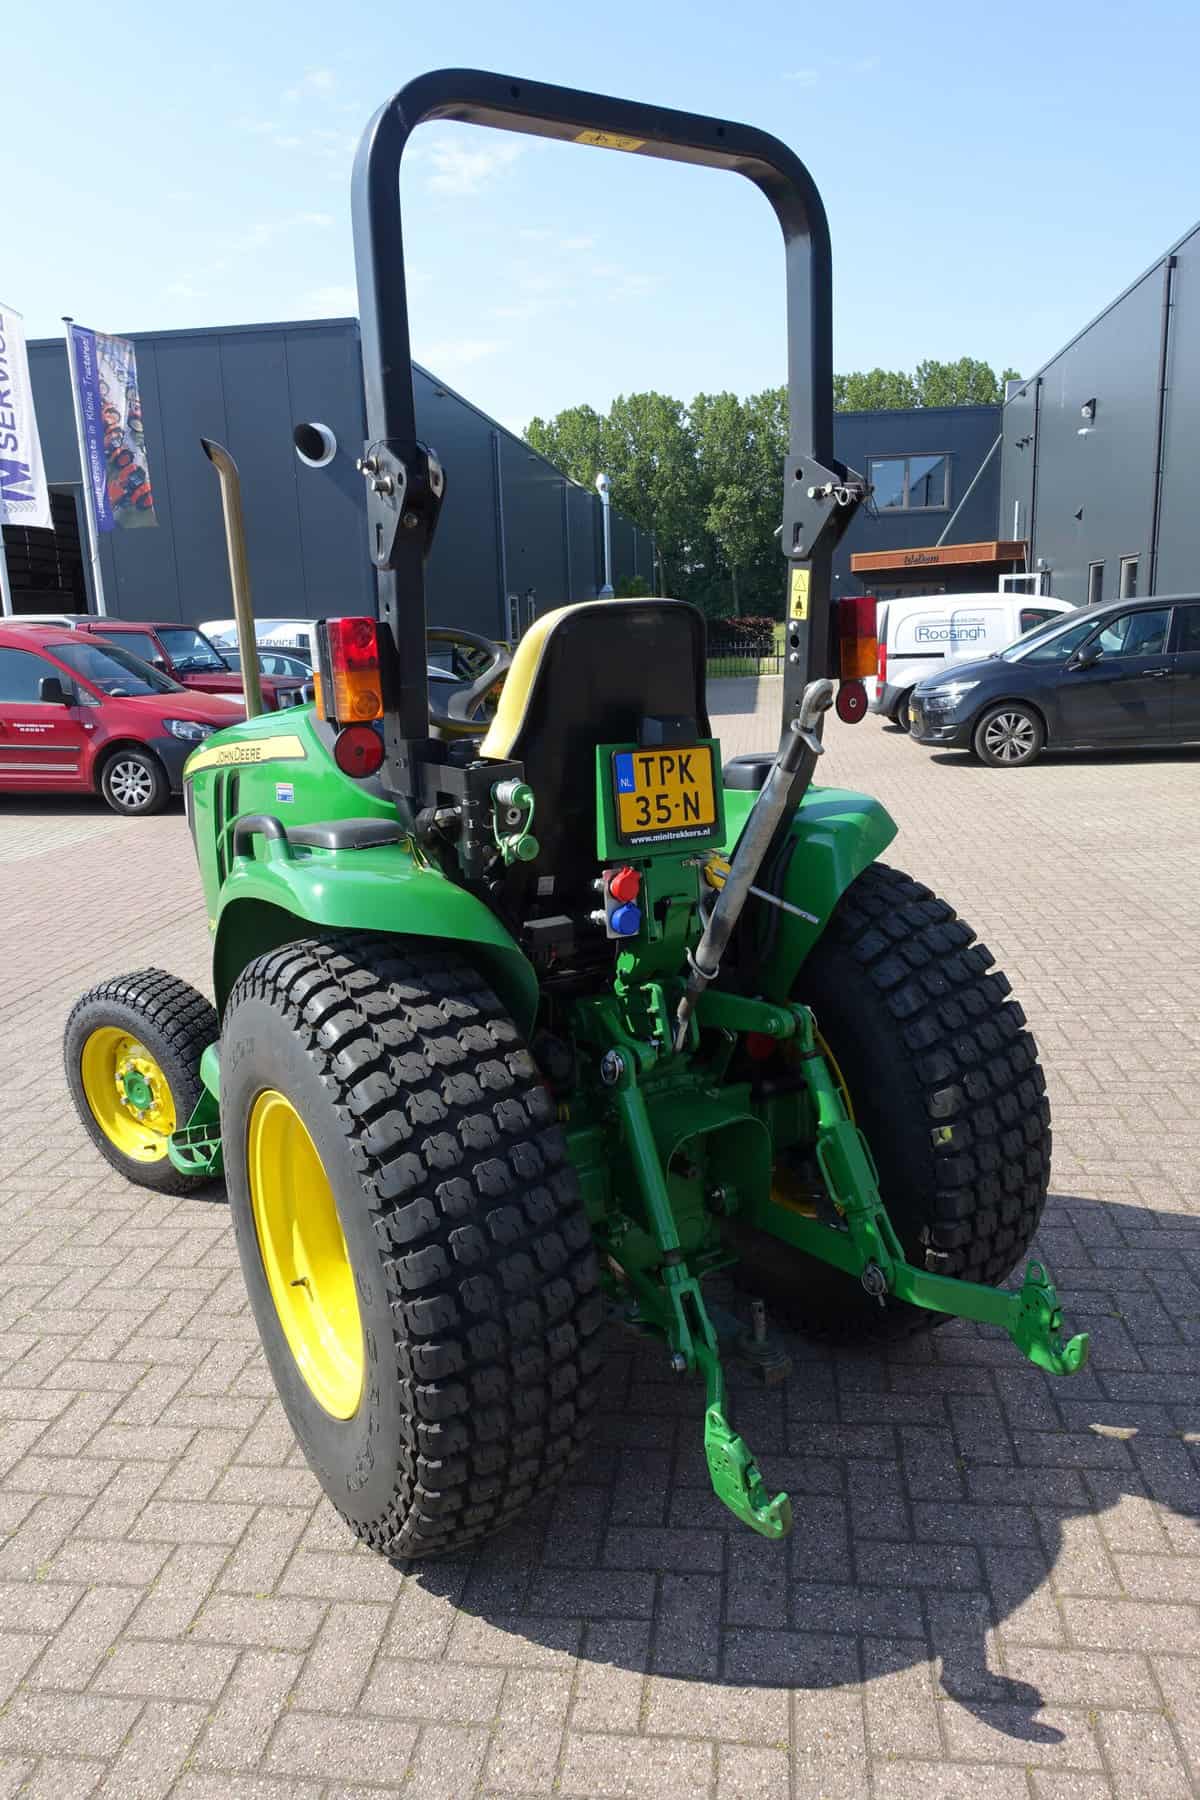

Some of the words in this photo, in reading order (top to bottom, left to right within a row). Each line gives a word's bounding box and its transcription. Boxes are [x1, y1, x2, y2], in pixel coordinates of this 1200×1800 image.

[85, 391, 96, 420] Kleine
[918, 626, 986, 641] Roosingh
[234, 746, 262, 761] DEERE
[638, 754, 696, 788] TPK
[620, 778, 632, 787] NL
[630, 827, 711, 844] www.minitrekkers.nl
